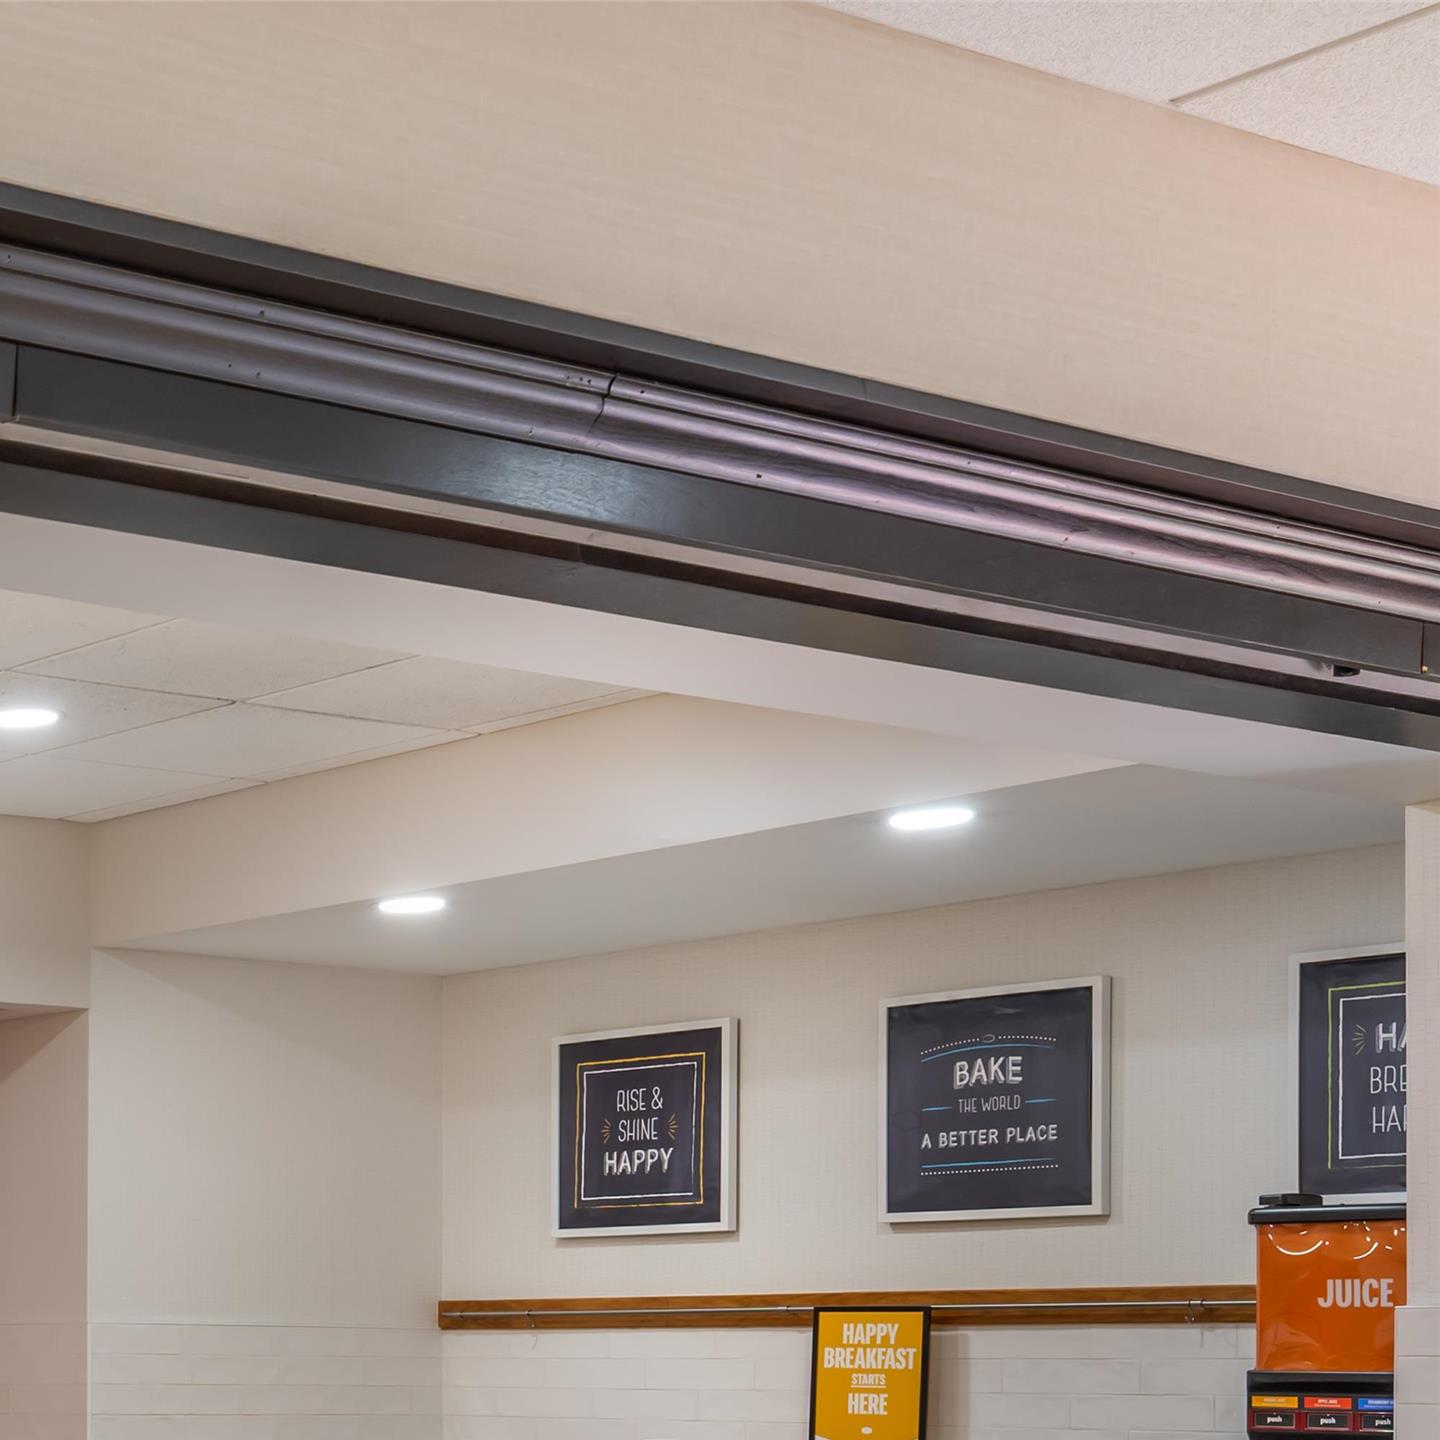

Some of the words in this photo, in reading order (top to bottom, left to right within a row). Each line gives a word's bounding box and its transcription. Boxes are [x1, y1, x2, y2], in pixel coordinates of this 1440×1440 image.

[953, 1055, 1023, 1089] BAKE
[616, 1087, 647, 1112] RISE
[651, 1086, 663, 1110] &
[958, 1098, 977, 1113] THE
[981, 1094, 1021, 1112] WORLD
[618, 1117, 659, 1142] SHINE
[921, 1133, 932, 1149] A
[938, 1128, 999, 1148] BETTER
[1006, 1124, 1058, 1144] PLACE
[603, 1147, 674, 1176] HAPPY
[1317, 1278, 1394, 1308] JUICE
[842, 1323, 899, 1345] HAPPY
[824, 1347, 917, 1369] BREAKFAST
[851, 1373, 886, 1385] STARTS
[847, 1392, 888, 1415] HERE
[1267, 1416, 1283, 1424] push
[1320, 1417, 1336, 1425] push
[1375, 1418, 1392, 1426] push
